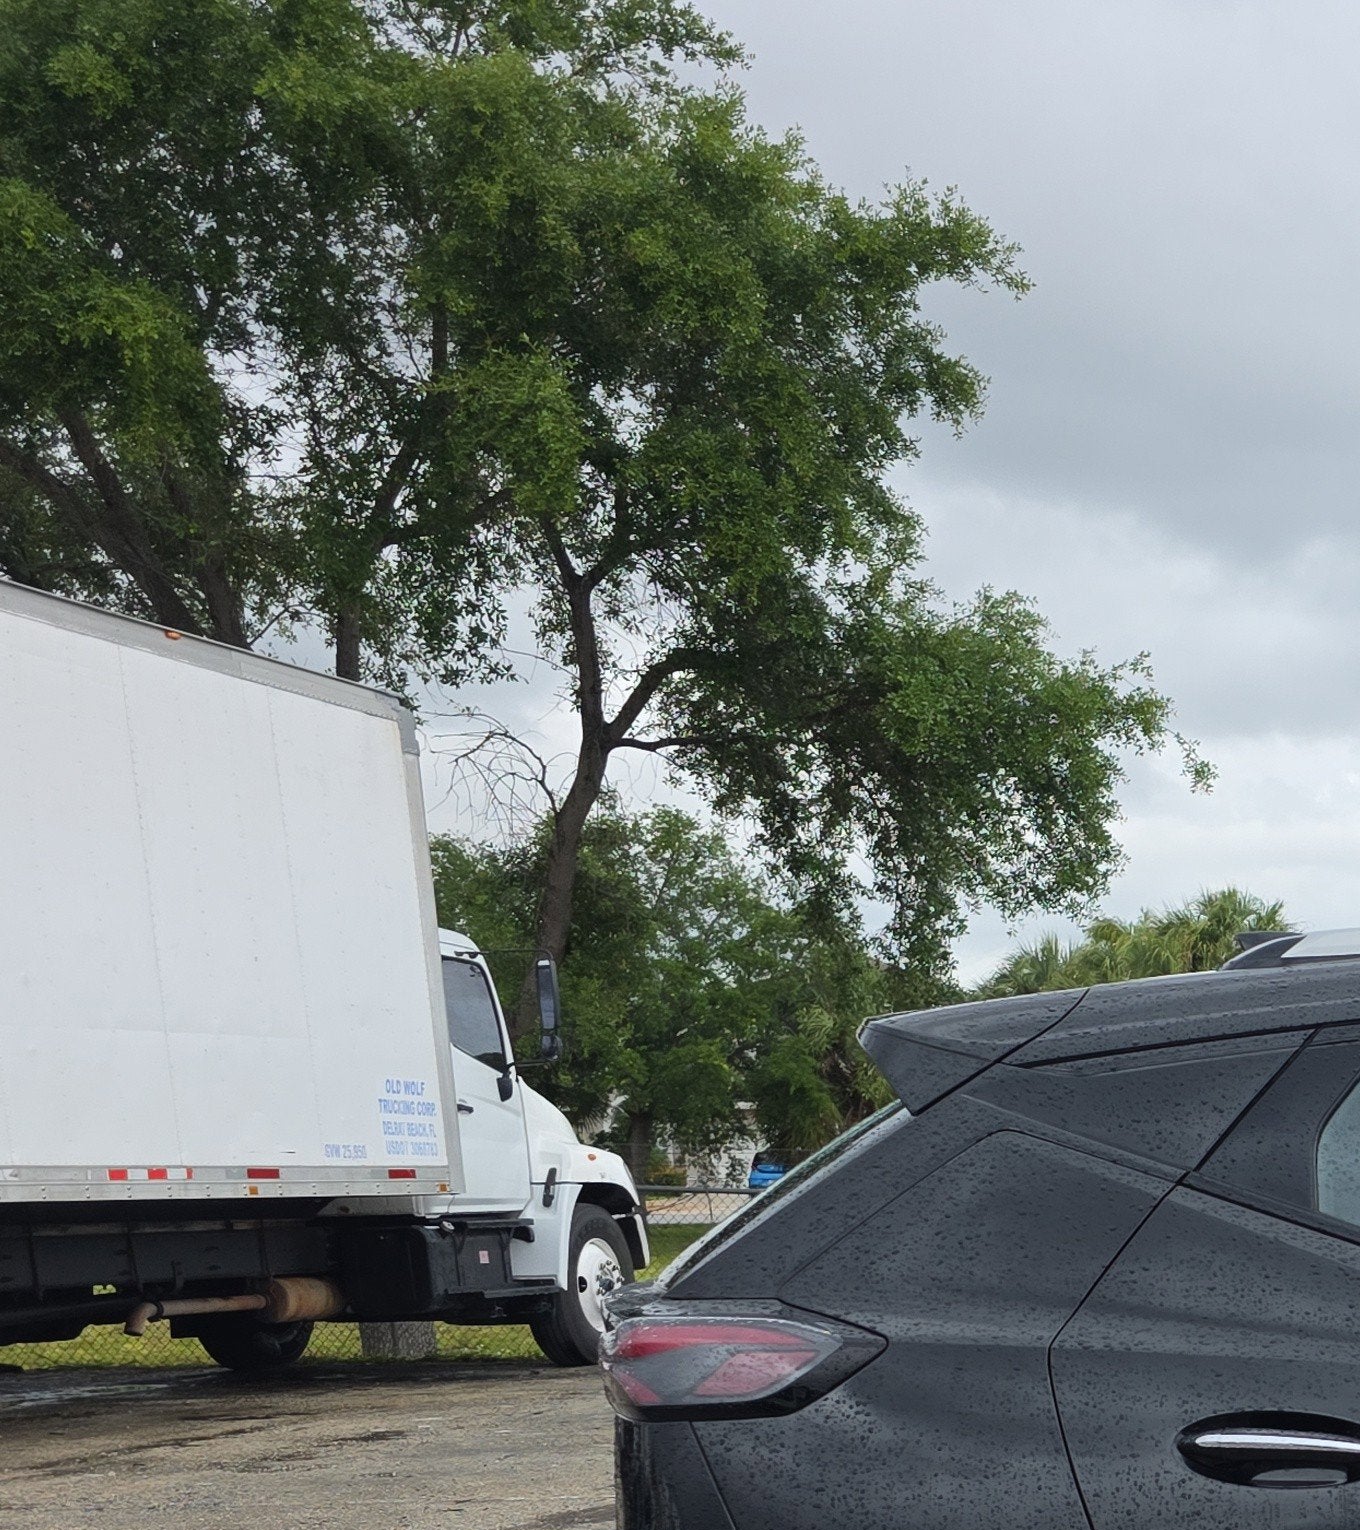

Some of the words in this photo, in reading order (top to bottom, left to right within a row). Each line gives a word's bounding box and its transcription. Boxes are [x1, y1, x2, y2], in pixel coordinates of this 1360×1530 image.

[385, 1079, 401, 1094] OLD
[403, 1080, 425, 1096] WOLF
[378, 1098, 415, 1115] TRUCKING
